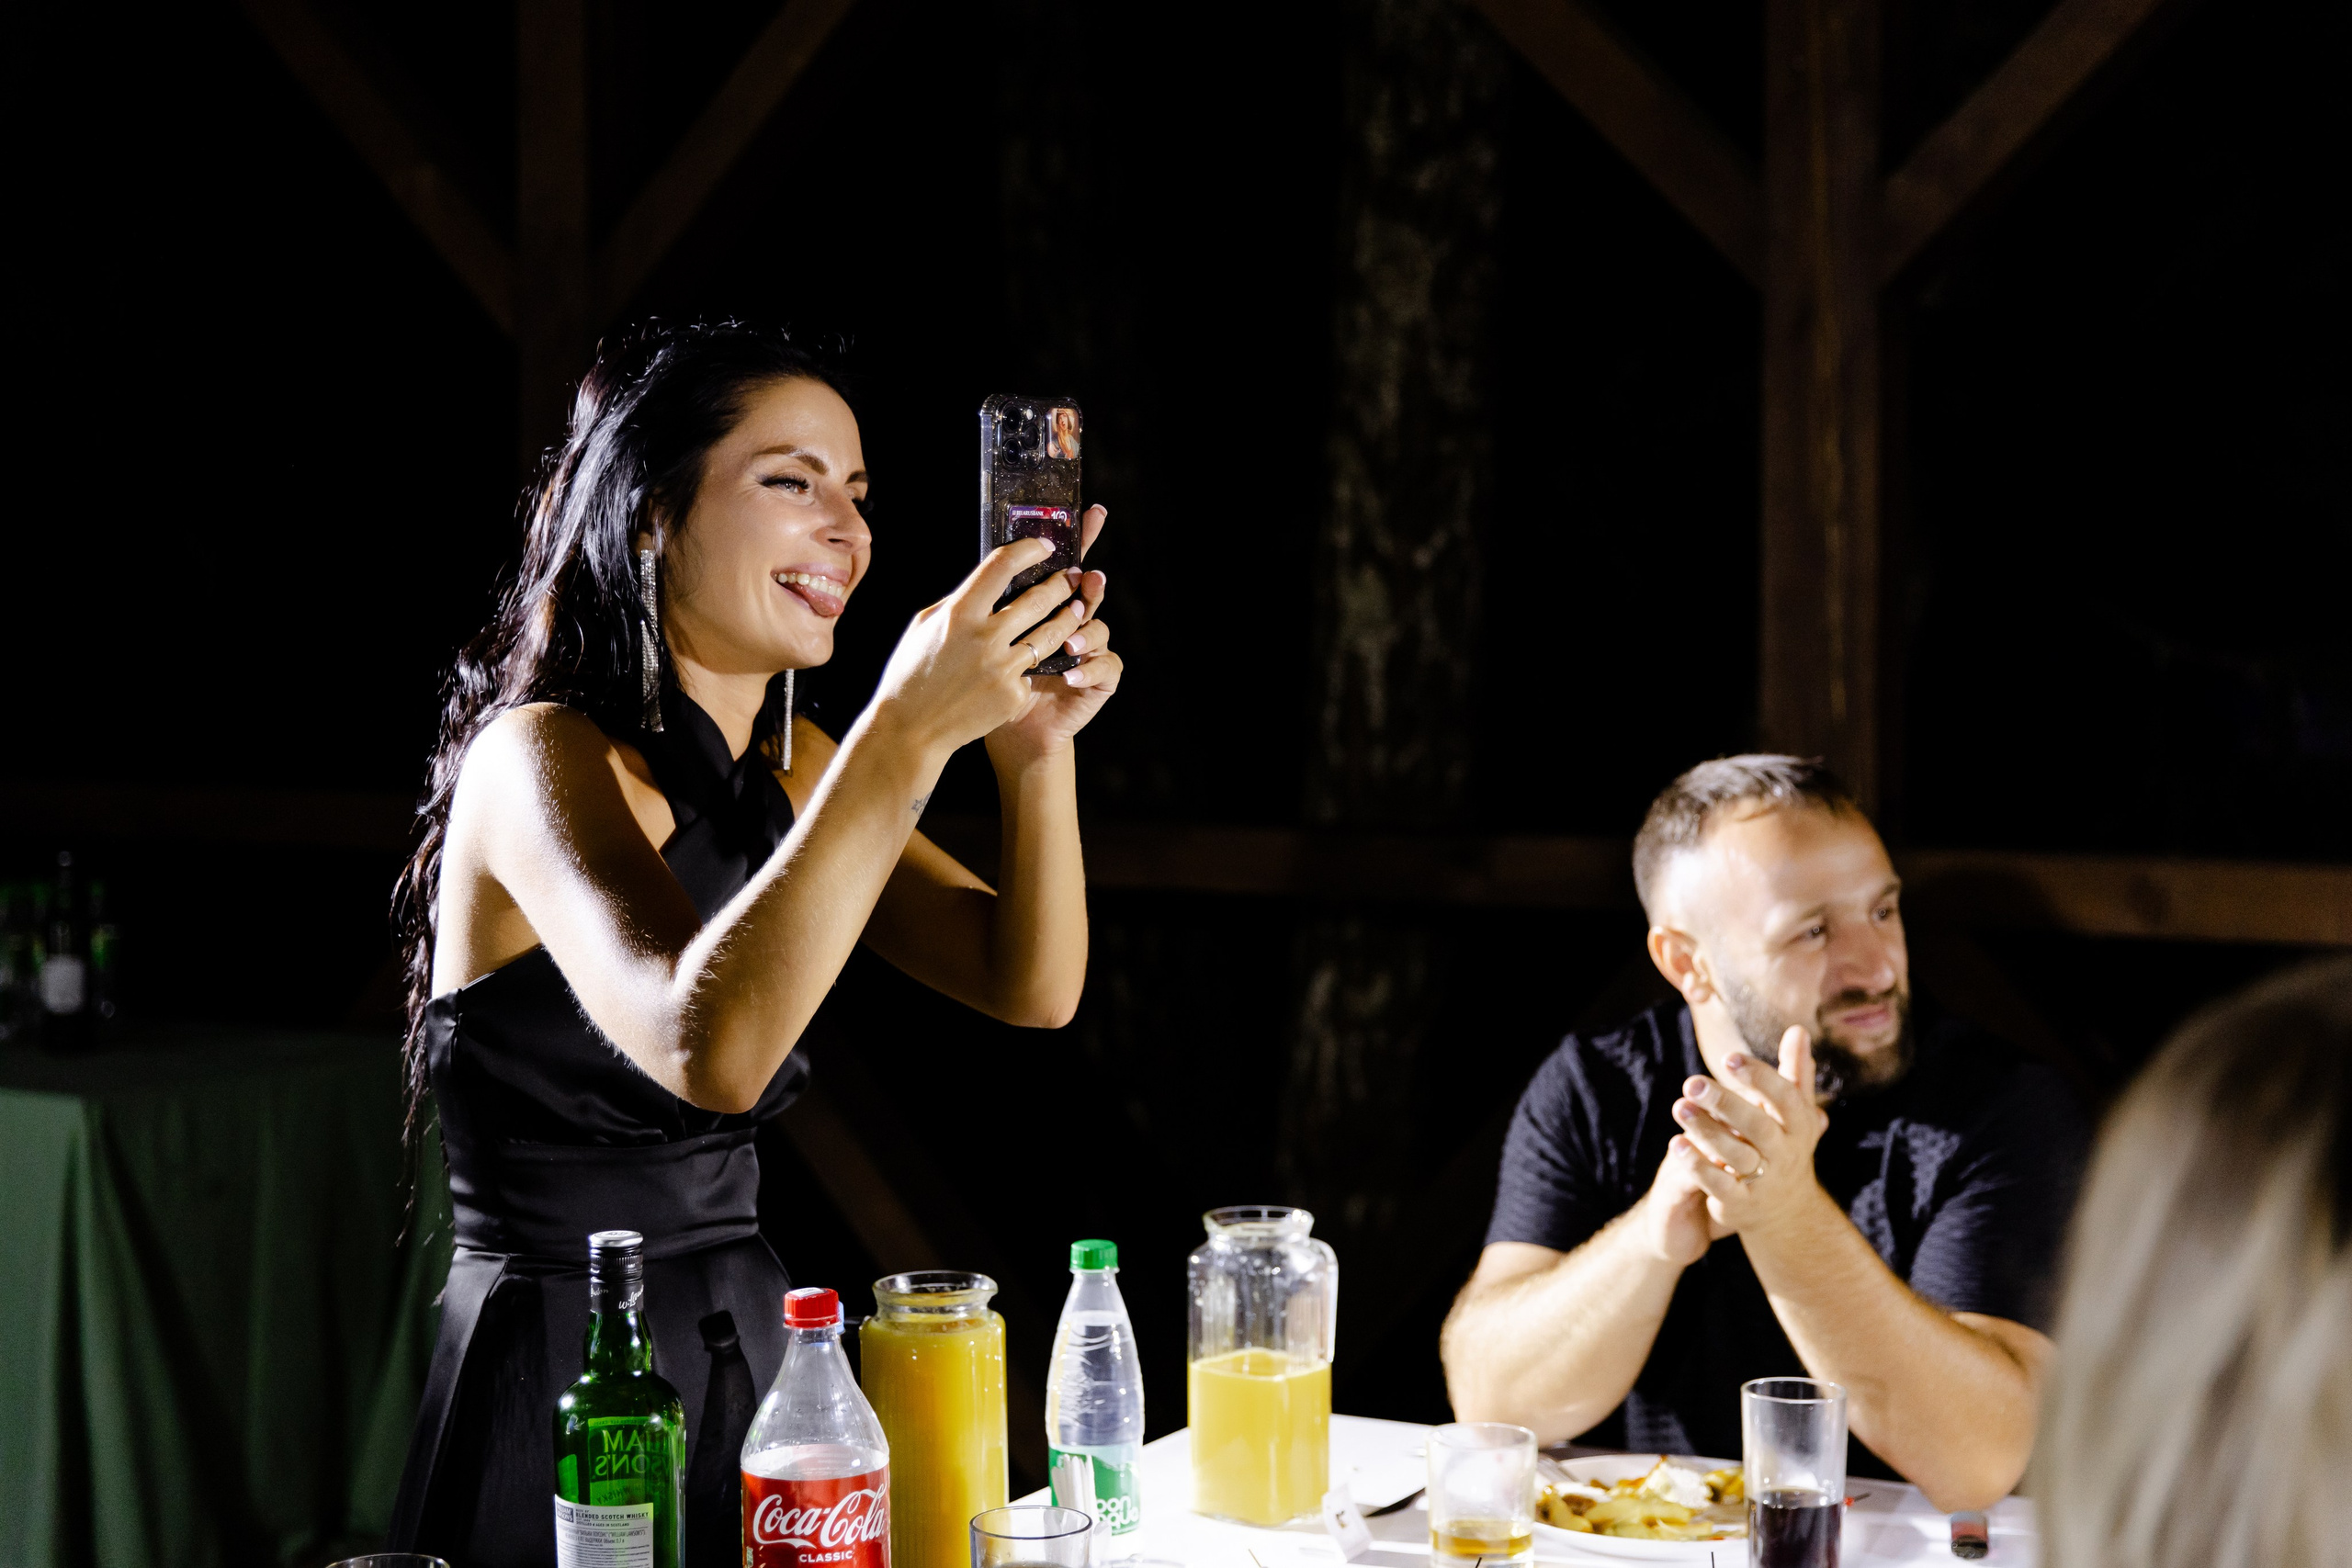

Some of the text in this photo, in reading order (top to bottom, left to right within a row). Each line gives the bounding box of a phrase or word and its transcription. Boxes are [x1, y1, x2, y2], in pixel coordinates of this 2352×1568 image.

[575, 1512, 599, 1520] BLENDED
[753, 1482, 888, 1549] Coca-Cola
[799, 1550, 854, 1562] CLASSIC
